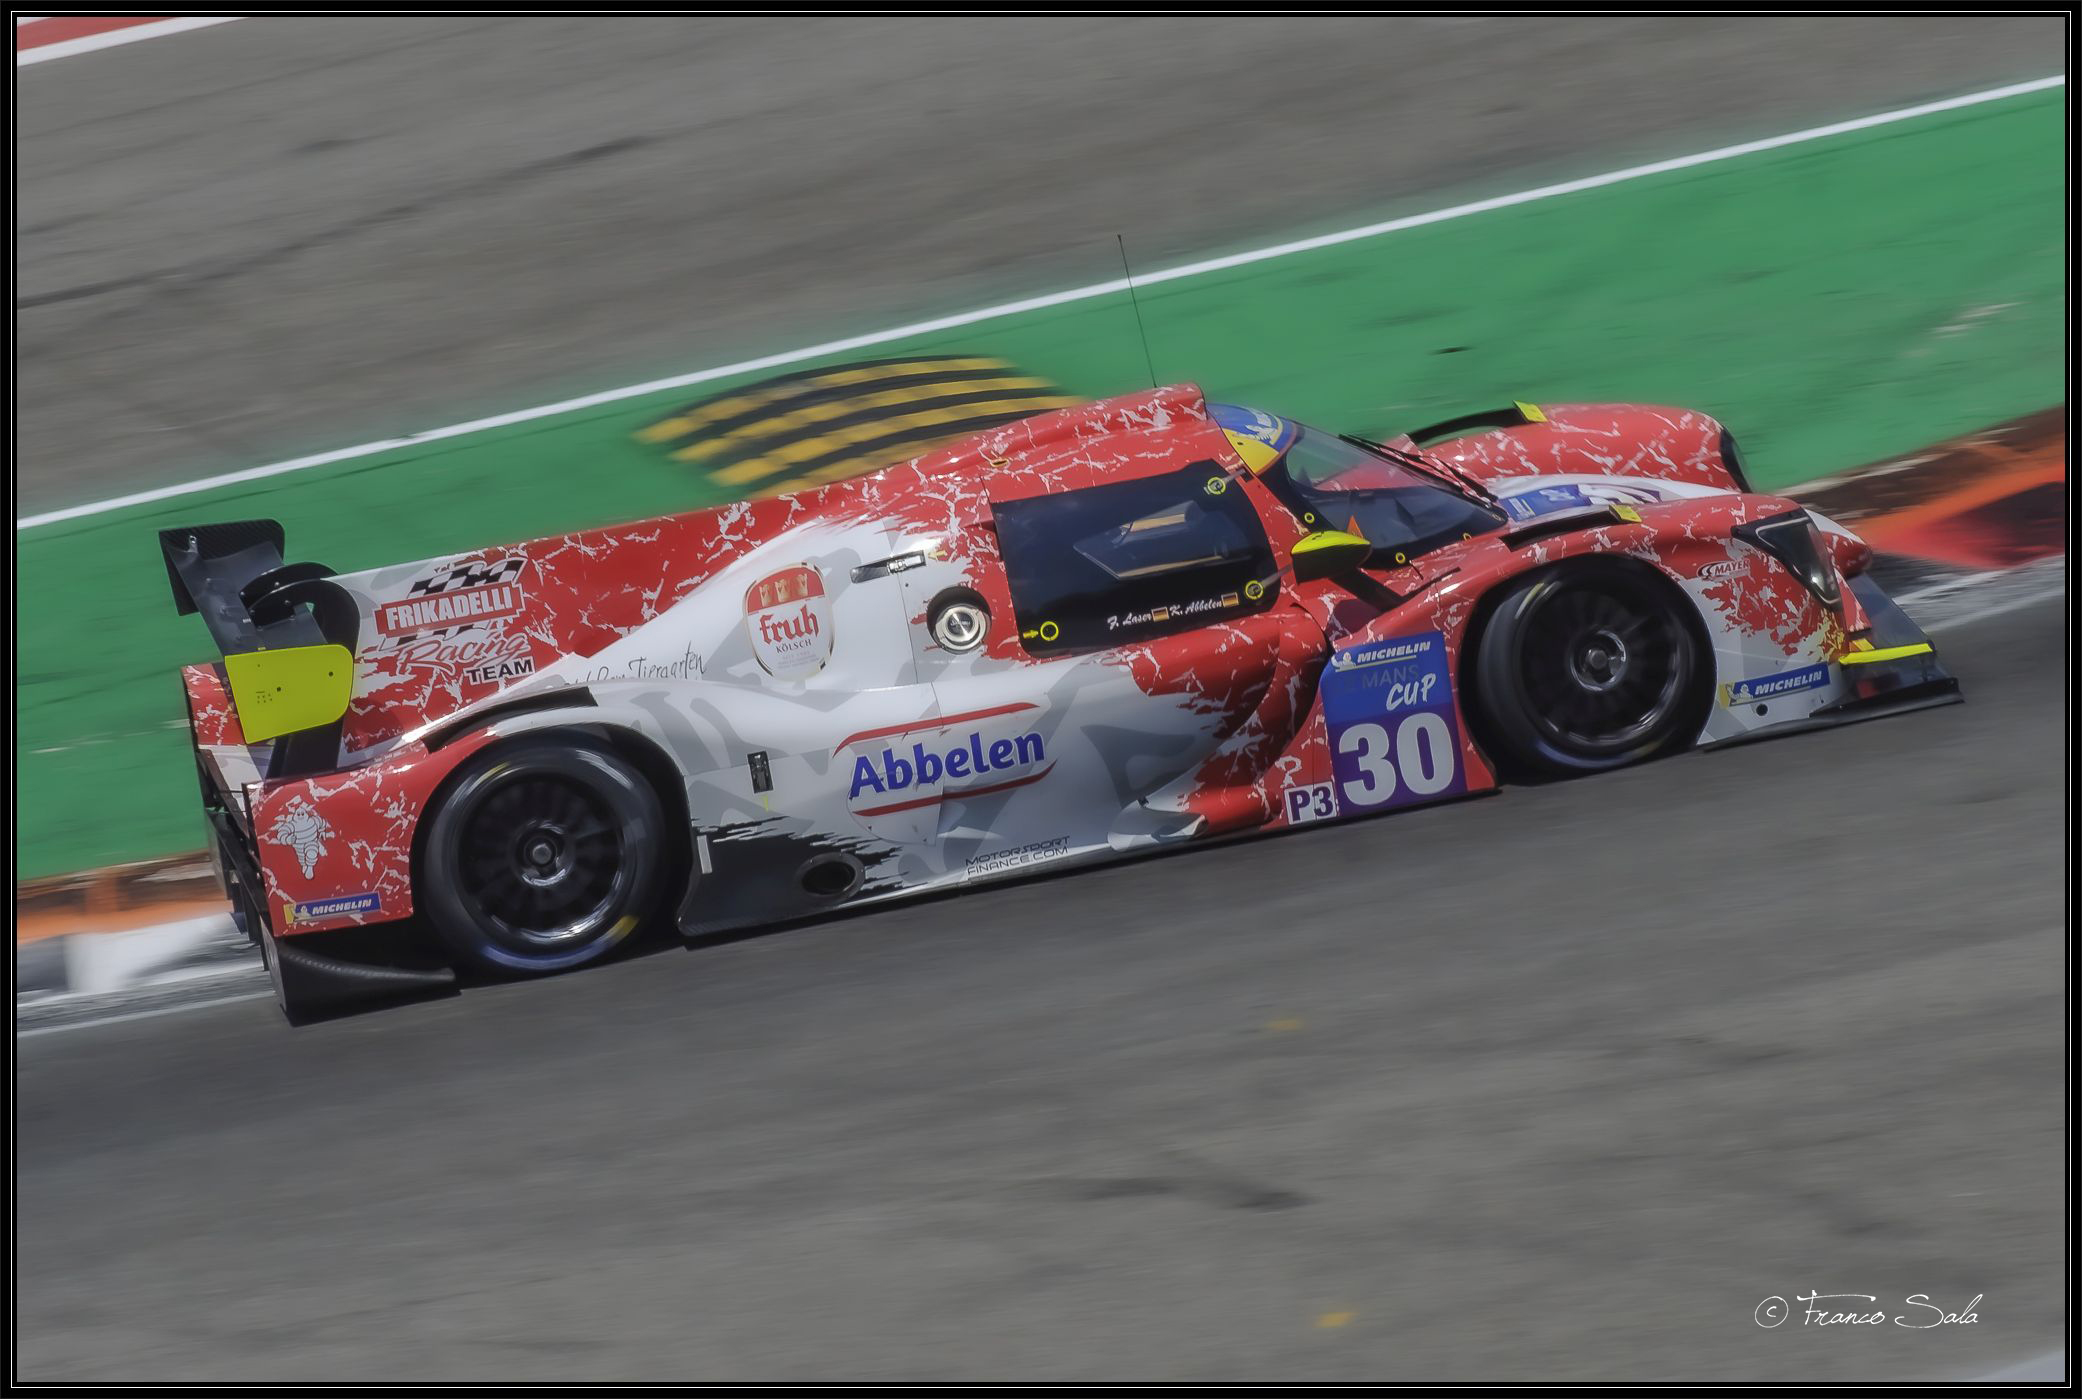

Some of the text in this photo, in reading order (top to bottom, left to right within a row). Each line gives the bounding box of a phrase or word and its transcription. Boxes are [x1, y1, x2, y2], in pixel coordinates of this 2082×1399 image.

[1715, 560, 1750, 576] MAYER
[385, 586, 513, 631] FRIKADELLI
[1107, 598, 1222, 631] F. Laser K. Abbelen
[398, 633, 531, 675] Racing
[775, 638, 812, 654] KÖLSCH
[1357, 640, 1431, 664] MICHELIN
[466, 659, 534, 684] TEAM
[1361, 664, 1420, 689] MANS
[1755, 670, 1823, 696] MICHELIN
[1385, 672, 1437, 712] CUP
[849, 731, 1045, 799] Abbelen
[1338, 712, 1455, 806] 30
[1288, 785, 1335, 822] P3
[965, 835, 1070, 867] MOTORSPORT
[312, 898, 372, 915] MICHELIN
